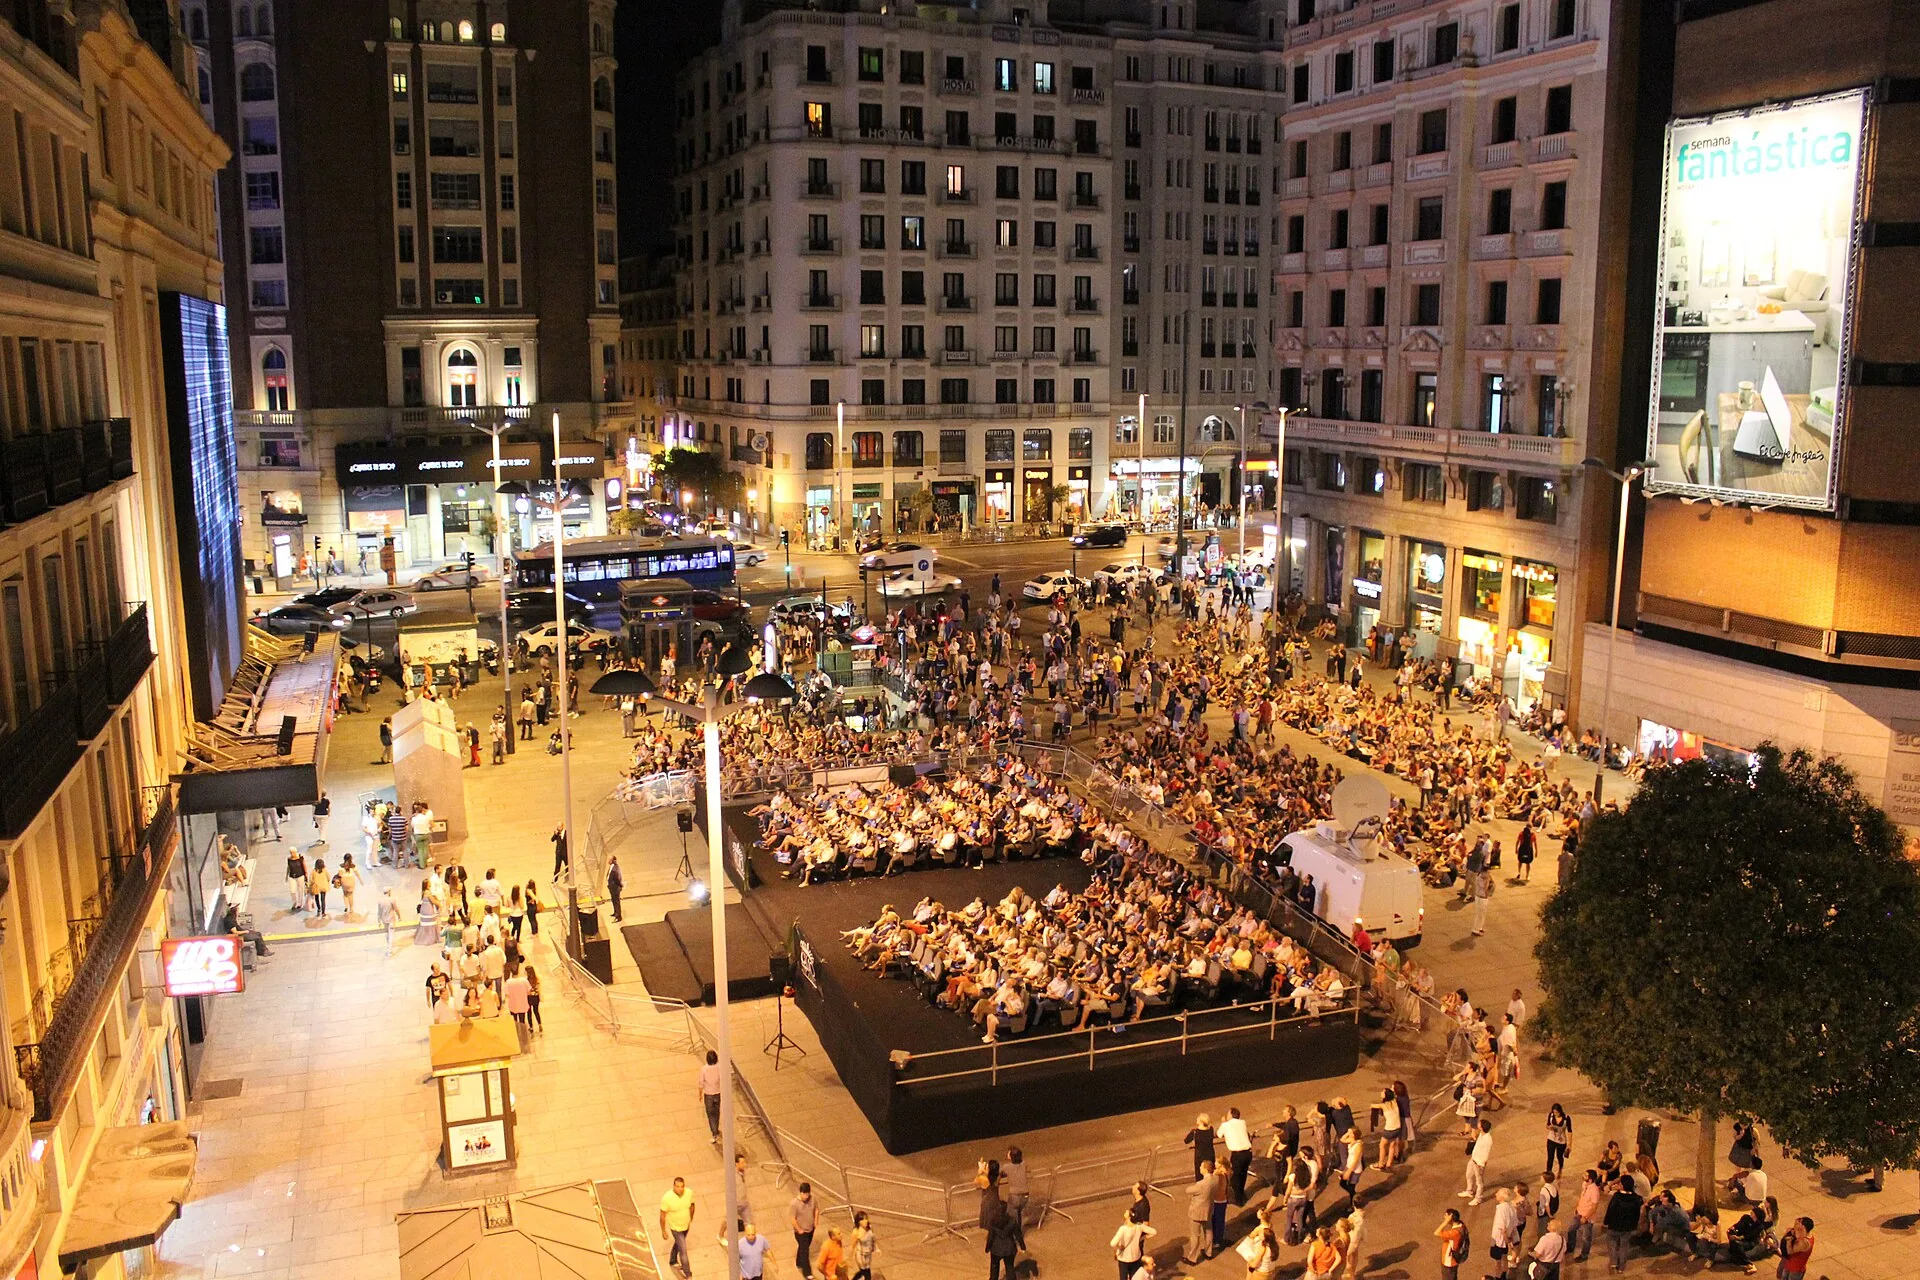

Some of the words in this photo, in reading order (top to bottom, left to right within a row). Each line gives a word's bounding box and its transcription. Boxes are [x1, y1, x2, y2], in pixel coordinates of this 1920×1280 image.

[944, 80, 976, 91] HOSTAL
[1074, 90, 1105, 101] MIAMI
[868, 128, 917, 141] HOSTAL
[999, 137, 1057, 149] JOSEFINA
[1691, 136, 1731, 151] semana
[1677, 127, 1852, 183] fantástica
[1759, 444, 1768, 457] El
[1769, 446, 1791, 459] Corte
[1791, 445, 1824, 464] Inglés
